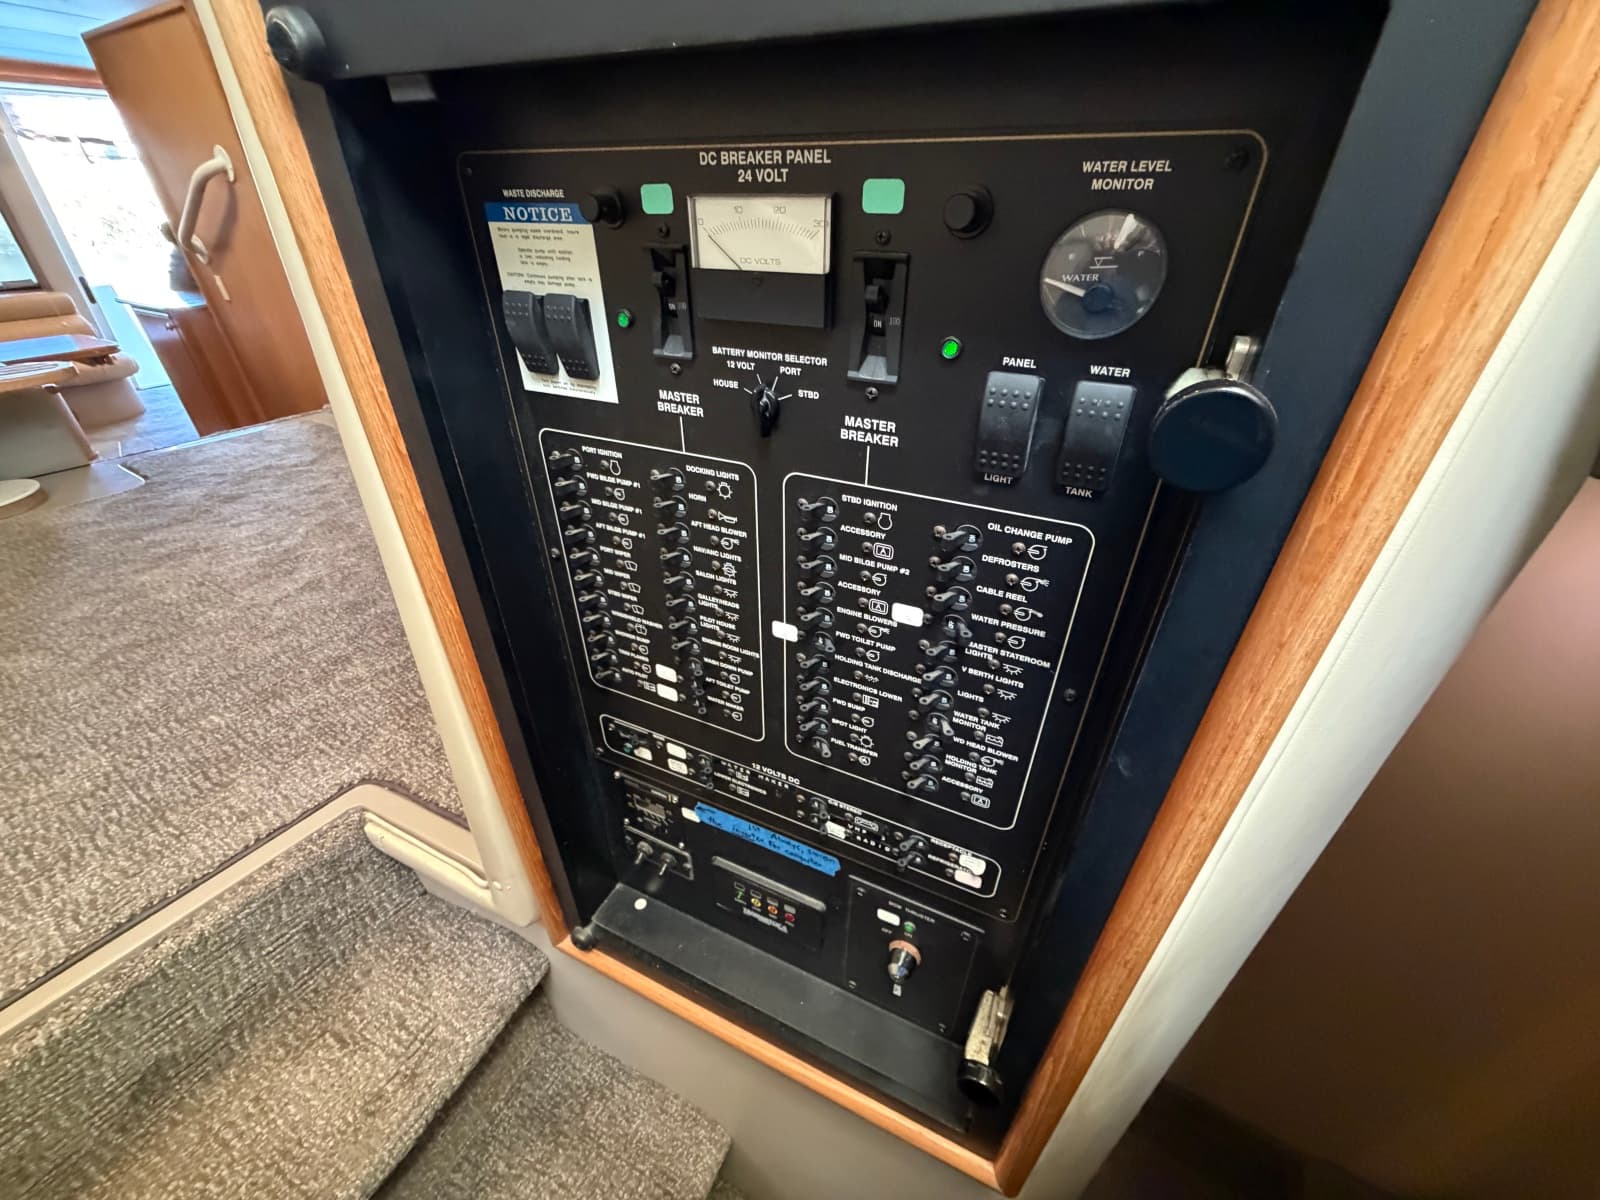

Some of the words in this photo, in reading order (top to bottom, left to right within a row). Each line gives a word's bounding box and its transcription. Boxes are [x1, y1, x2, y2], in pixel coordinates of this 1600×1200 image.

[699, 151, 718, 166] DC
[720, 150, 783, 165] BREAKER
[786, 149, 832, 164] PANEL
[1082, 160, 1128, 173] WATER
[1130, 160, 1173, 172] LEVEL
[737, 169, 753, 183] 24
[755, 168, 789, 182] VOLT
[1091, 178, 1154, 190] MONITOR
[502, 189, 525, 198] WASTE
[525, 189, 565, 198] DISCHARGE
[502, 206, 573, 222] NOTICE
[740, 257, 752, 265] DC
[754, 258, 782, 266] VOLTS
[1062, 273, 1099, 282] WATER
[712, 346, 746, 358] BATTERY
[746, 349, 783, 362] MONITOR
[784, 353, 828, 367] SELECTOR
[1002, 356, 1037, 369] PANEL
[726, 360, 736, 369] 12
[736, 361, 756, 371] VOLT
[779, 366, 802, 377] PORT
[1089, 364, 1131, 378] WATER
[713, 378, 739, 389] HOUSE
[658, 389, 700, 405] MASTER
[798, 389, 820, 400] STBD
[657, 402, 704, 417] BREAKER
[844, 415, 897, 433] MASTER
[840, 428, 899, 448] BREAKER
[581, 445, 598, 454] PORT
[597, 447, 623, 459] IGNITION
[685, 464, 715, 477] DOCKING
[715, 470, 740, 481] LIGHTS
[984, 473, 1014, 485] LIGHT
[688, 492, 707, 503] HORN
[1065, 486, 1093, 498] TANK
[841, 494, 862, 505] STBD
[863, 498, 898, 512] IGNITION
[690, 520, 703, 528] AFT
[703, 522, 720, 532] HEAD
[720, 526, 748, 539] BLOWER
[840, 524, 887, 540] ACCESSORY
[987, 522, 1003, 532] OIL
[1003, 526, 1043, 540] CHANGE
[1044, 533, 1073, 545] PUMP
[719, 551, 742, 563] LIGHTS
[839, 553, 853, 562] MID
[853, 557, 876, 568] BILGE
[876, 561, 899, 573] PUMP
[899, 567, 910, 576] #2
[981, 554, 1041, 573] DEFROSTERS
[715, 574, 737, 586] LIGHTS
[837, 581, 882, 596] ACCESSORY
[976, 585, 1004, 598] CABLE
[1005, 592, 1029, 603] REEL
[698, 599, 719, 610] LIGHTS
[699, 615, 715, 624] PILOT
[715, 620, 736, 630] HOUSE
[836, 606, 863, 618] ENGINE
[863, 613, 898, 628] BLOWERS
[699, 621, 720, 632] LIGHTS
[971, 613, 1000, 627] WATER
[1000, 620, 1047, 638] PRESSURE
[835, 631, 851, 640] FWD
[851, 636, 876, 647] TOILET
[876, 641, 897, 652] PUMP
[965, 648, 994, 661] LIGHTS
[999, 650, 1052, 669] STATEROOM
[834, 654, 864, 668] HOLDING
[864, 662, 883, 673] TANK
[882, 667, 923, 685] DISCHARGE
[961, 665, 968, 673] V
[968, 668, 995, 681] BERTH
[995, 675, 1025, 689] LIGHTS
[833, 676, 879, 695] ELECTRONICS
[879, 690, 903, 703] LOWER
[957, 690, 985, 703] LIGHTS
[832, 697, 847, 706] FWD
[831, 718, 849, 728] SPOT
[848, 723, 868, 734] LIGHT
[952, 717, 987, 732] MONITOR
[953, 710, 979, 723] WATER
[980, 718, 1001, 730] TANK
[830, 737, 846, 747] FUEL
[966, 740, 987, 752] HEAD
[987, 746, 1020, 762] BLOWER
[944, 759, 978, 774] MONITOR
[945, 754, 978, 769] HOLDING
[978, 764, 999, 776] TANK
[751, 762, 761, 771] 12
[761, 765, 787, 780] VOLTS
[787, 775, 800, 785] DC
[941, 776, 984, 794] ACCESSORY
